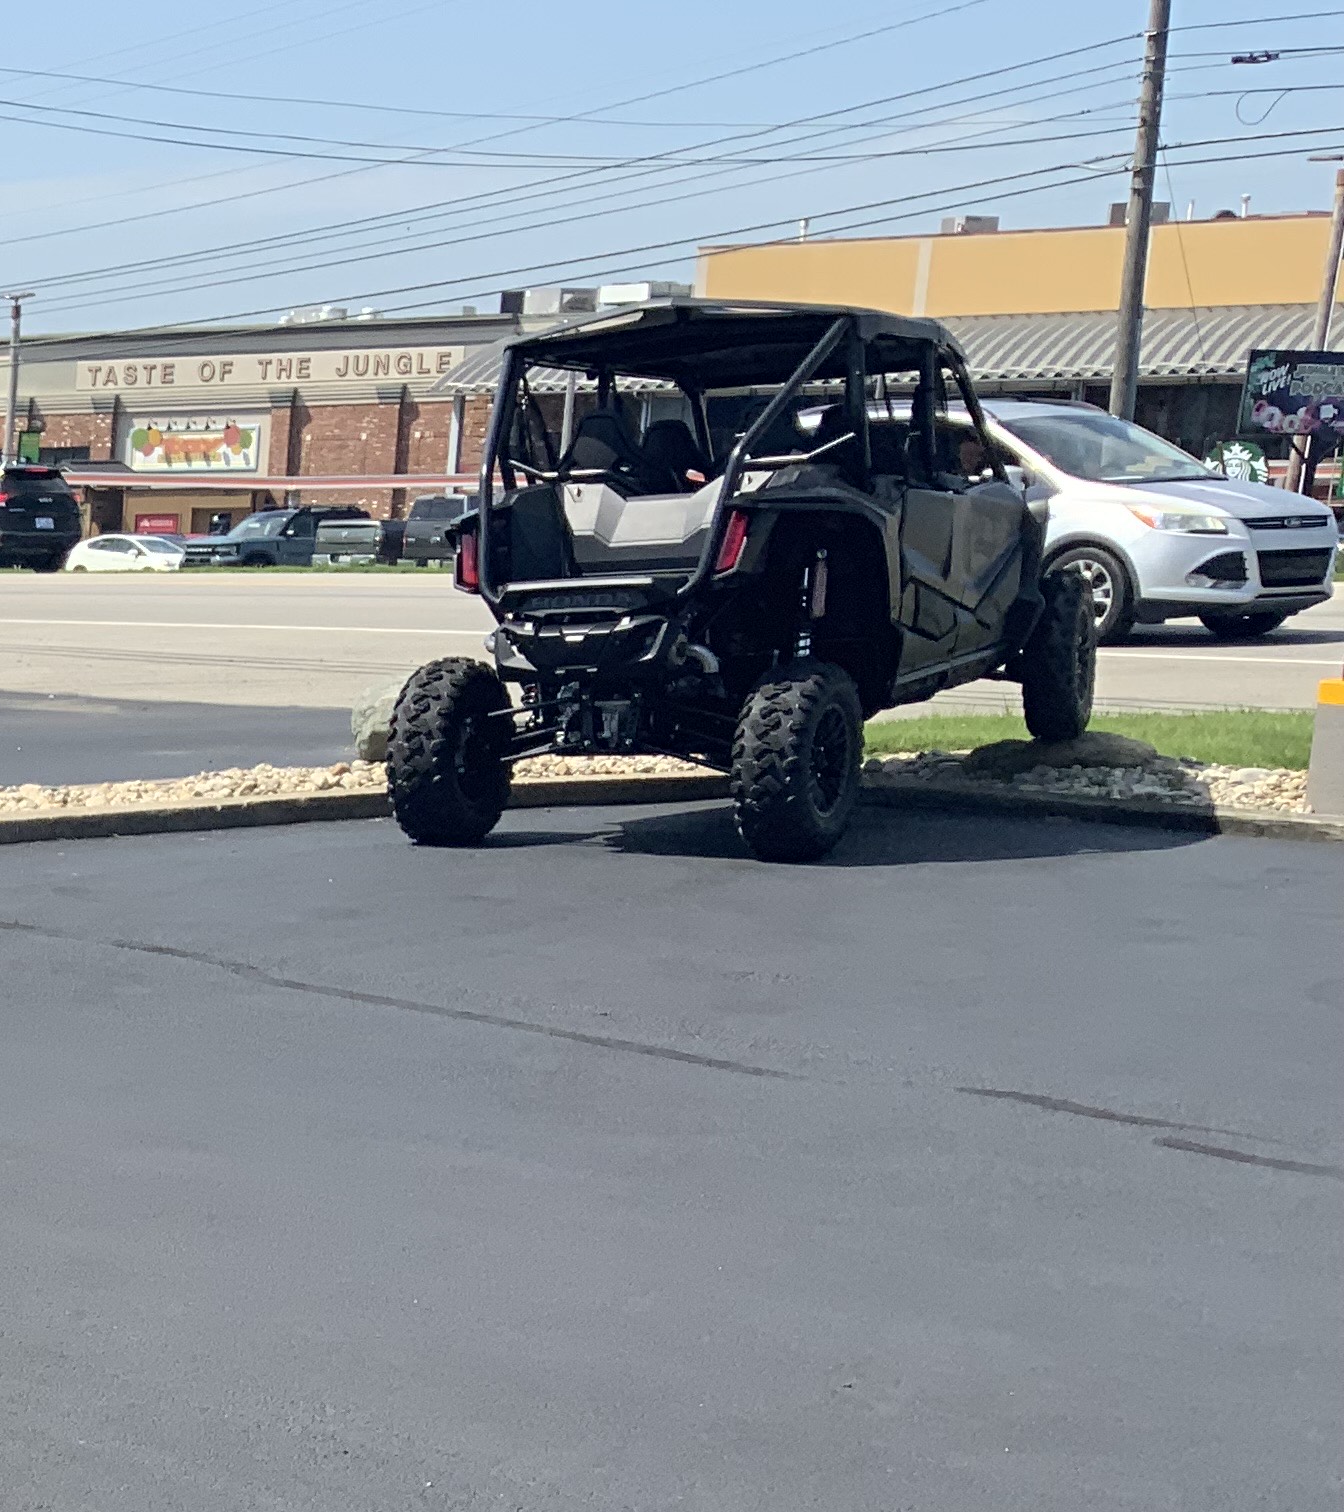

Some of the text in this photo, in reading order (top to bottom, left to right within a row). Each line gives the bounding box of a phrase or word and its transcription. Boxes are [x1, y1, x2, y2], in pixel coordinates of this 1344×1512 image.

[87, 351, 453, 387] TASTE OF THE JUNGLE
